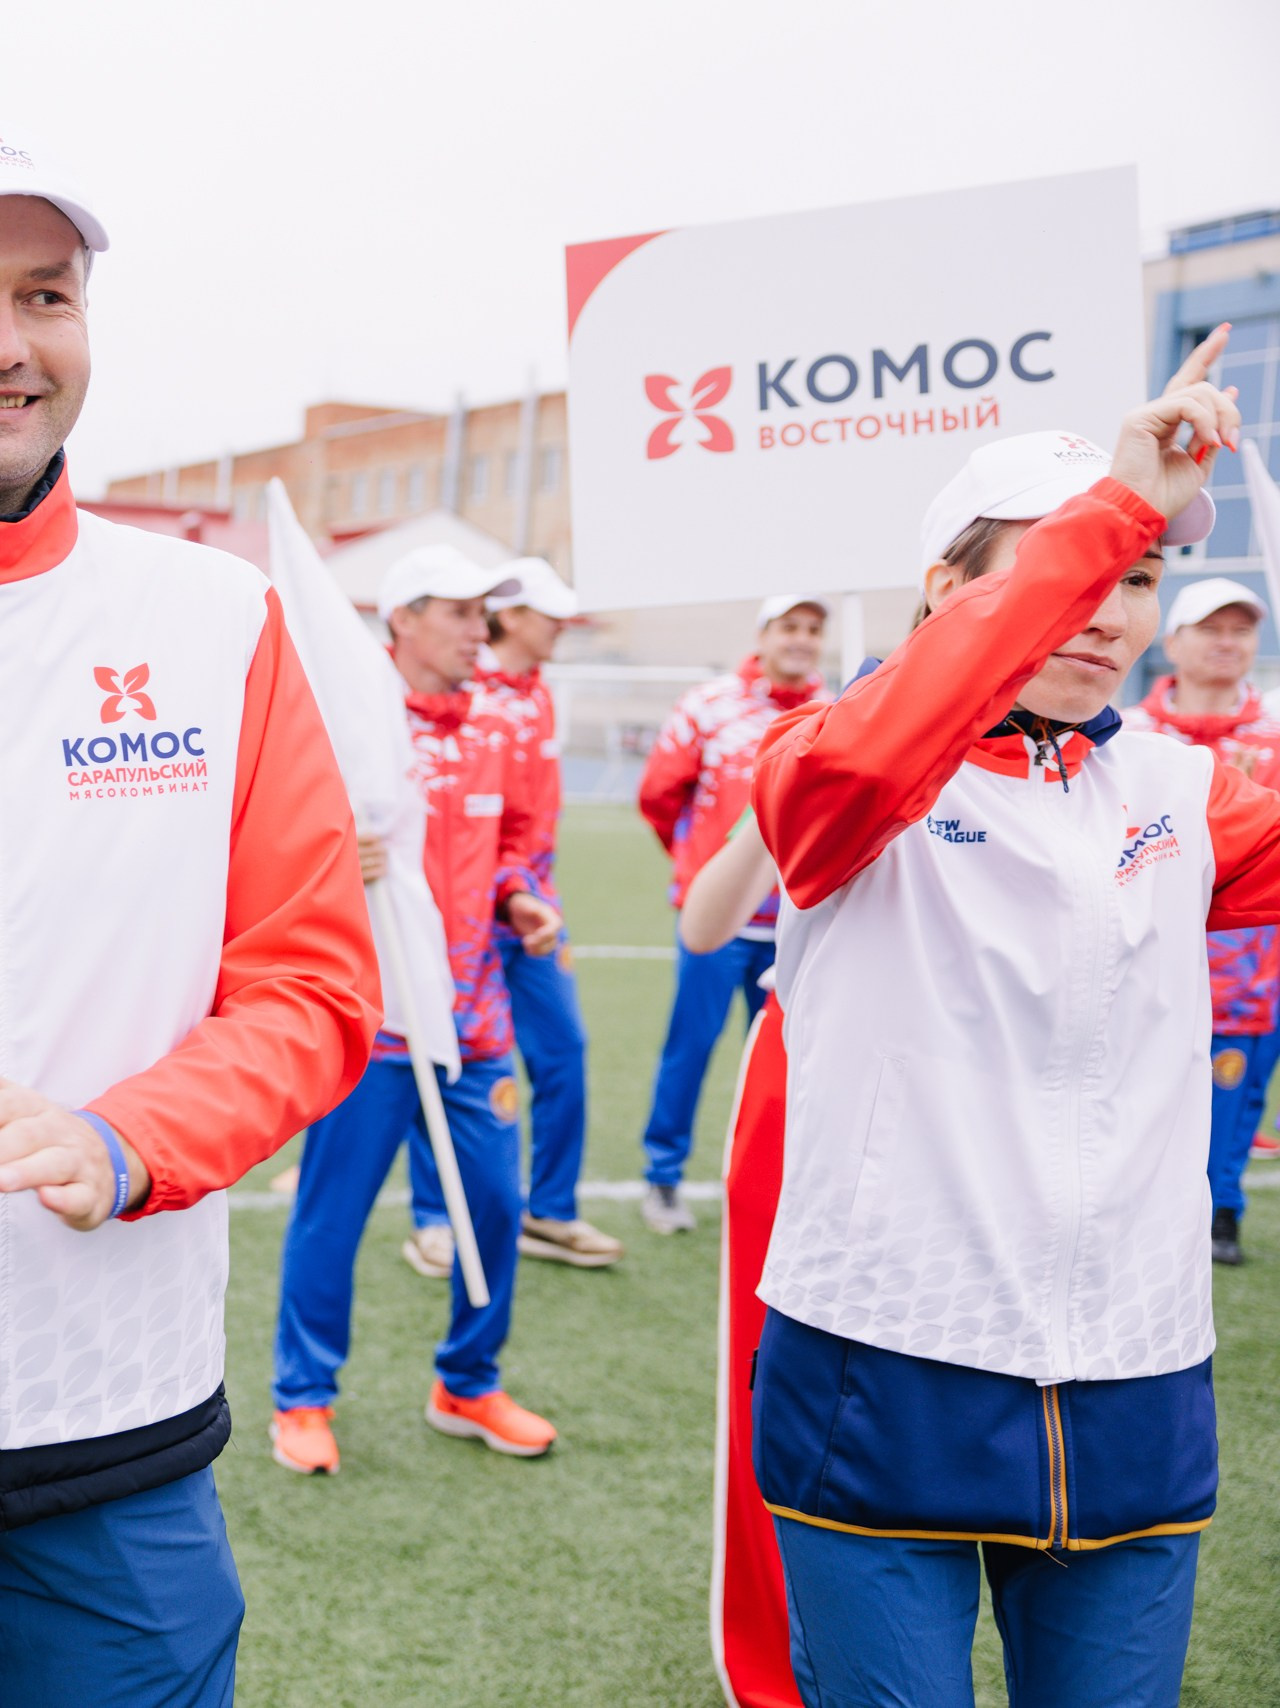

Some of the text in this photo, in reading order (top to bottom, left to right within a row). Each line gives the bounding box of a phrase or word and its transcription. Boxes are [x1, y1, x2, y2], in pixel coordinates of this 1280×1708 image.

[758, 331, 1056, 412] КОМОС
[759, 396, 1001, 450] ВОСТОЧНЫЙ
[62, 727, 205, 767] КОМОС
[67, 759, 208, 787] САРАПУЛЬСКИЙ
[69, 781, 209, 801] МЯСОКОМБИНАТ
[927, 814, 961, 831] EW
[929, 827, 987, 843] AGUE
[1117, 814, 1174, 868] МОС
